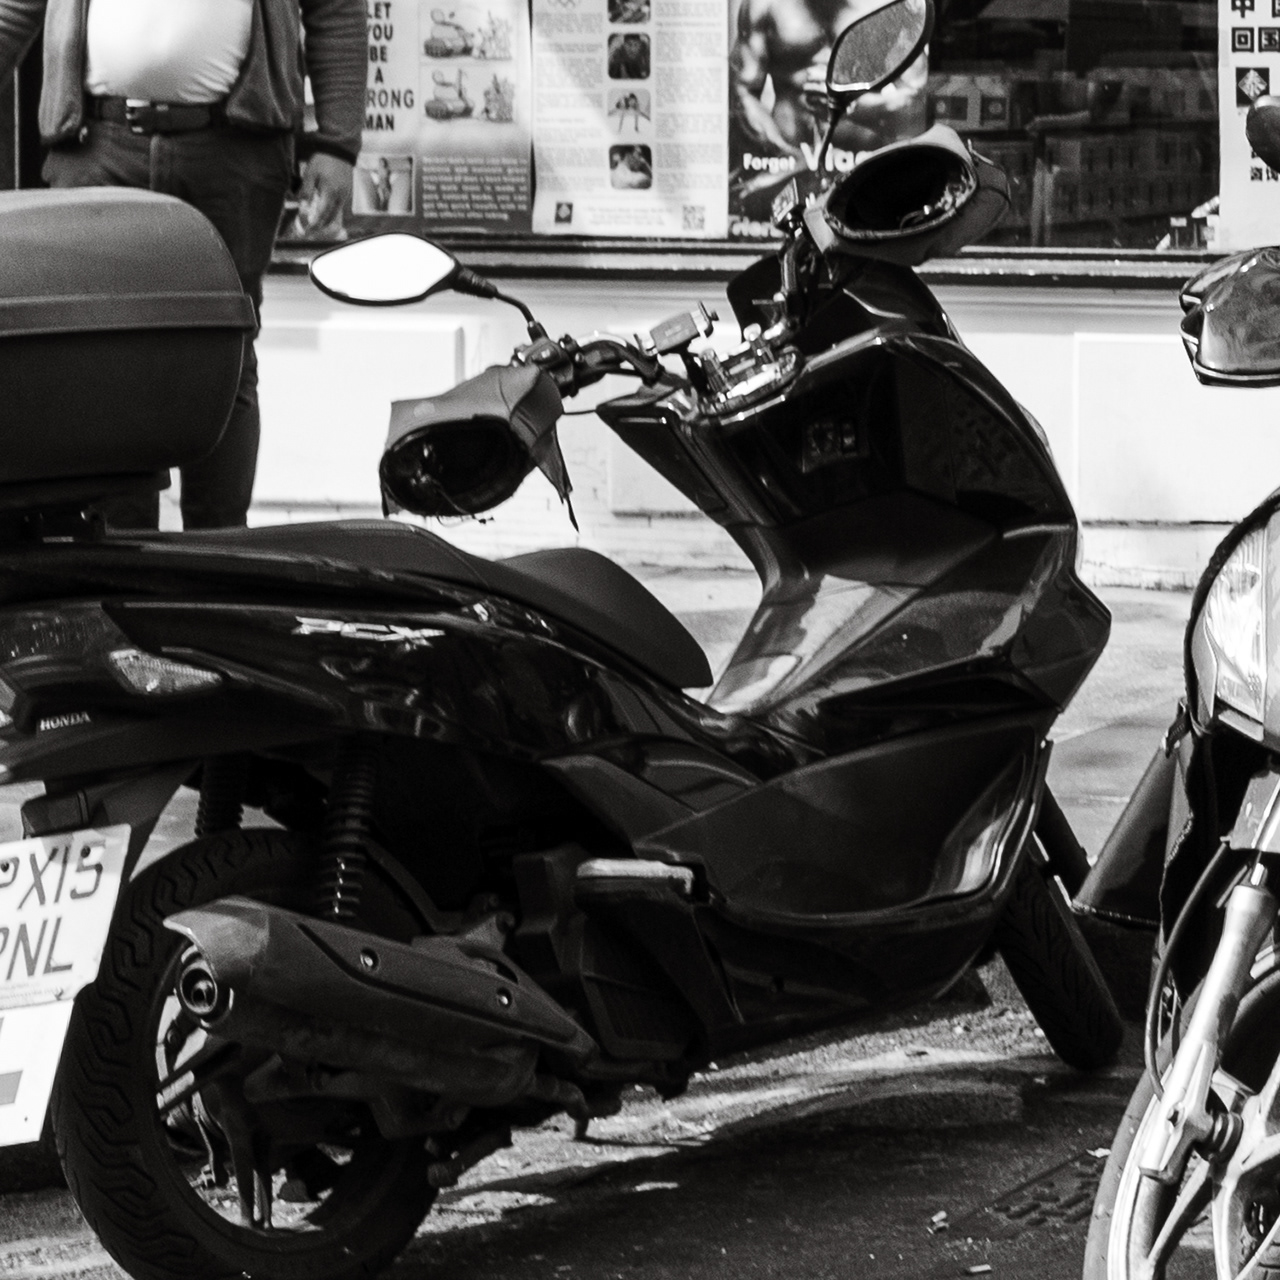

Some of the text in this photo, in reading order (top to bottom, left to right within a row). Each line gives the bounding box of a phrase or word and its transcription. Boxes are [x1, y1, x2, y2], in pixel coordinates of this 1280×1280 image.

[374, 66, 384, 85] A
[367, 89, 415, 110] RONG
[743, 152, 796, 174] Forget
[39, 710, 91, 732] HONDA
